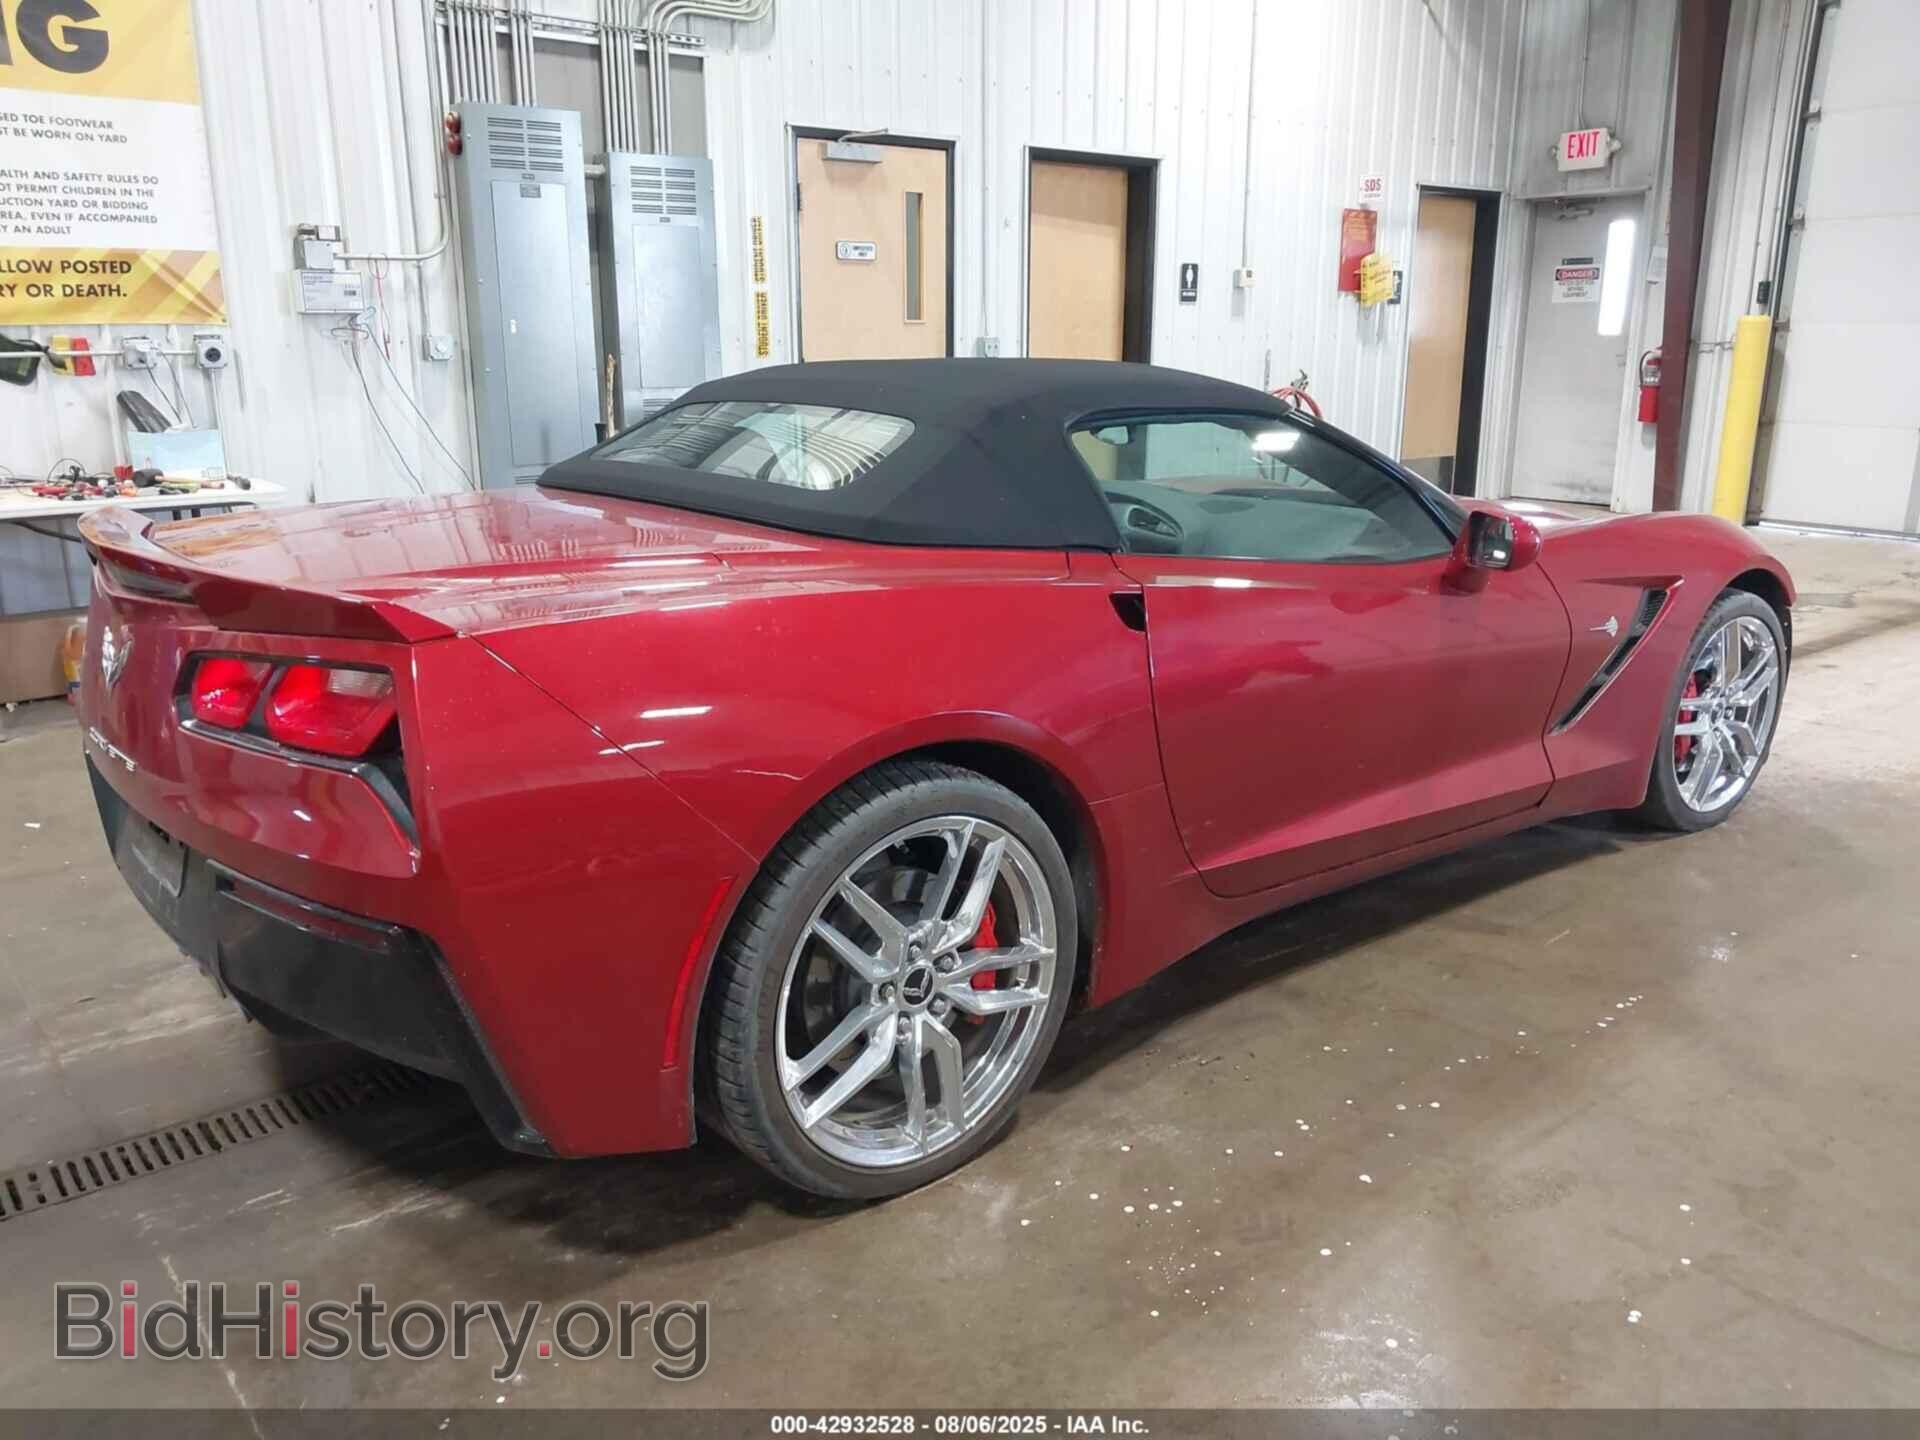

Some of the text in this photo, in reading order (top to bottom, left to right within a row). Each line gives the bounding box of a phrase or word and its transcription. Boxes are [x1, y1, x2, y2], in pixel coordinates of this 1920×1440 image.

[22, 114, 46, 124] TOE
[49, 117, 113, 129] FOOTWEAR
[13, 128, 26, 137] BE
[31, 129, 71, 140] WORN
[75, 132, 94, 142] ON
[97, 134, 128, 144] YARD
[1567, 131, 1600, 159] EXIT
[0, 169, 159, 185] ALTH AND SAFETY RULES DO
[16, 184, 57, 193] PERMIT
[62, 186, 116, 196] CHILDREN
[120, 188, 132, 196] IN
[136, 188, 154, 198] THE
[1364, 178, 1381, 192] SDS
[48, 199, 78, 208] YARD
[81, 200, 98, 209] OR
[102, 200, 149, 210] BIDDING
[31, 212, 61, 221] EVEN
[65, 213, 73, 221] IF
[78, 214, 158, 224] ACCOMPANIED
[14, 225, 31, 233] AN
[36, 226, 72, 235] ADULT
[61, 259, 132, 274] POSTED
[26, 284, 54, 297] OR
[62, 284, 127, 297] DEATH.
[757, 322, 769, 356] STUDENT
